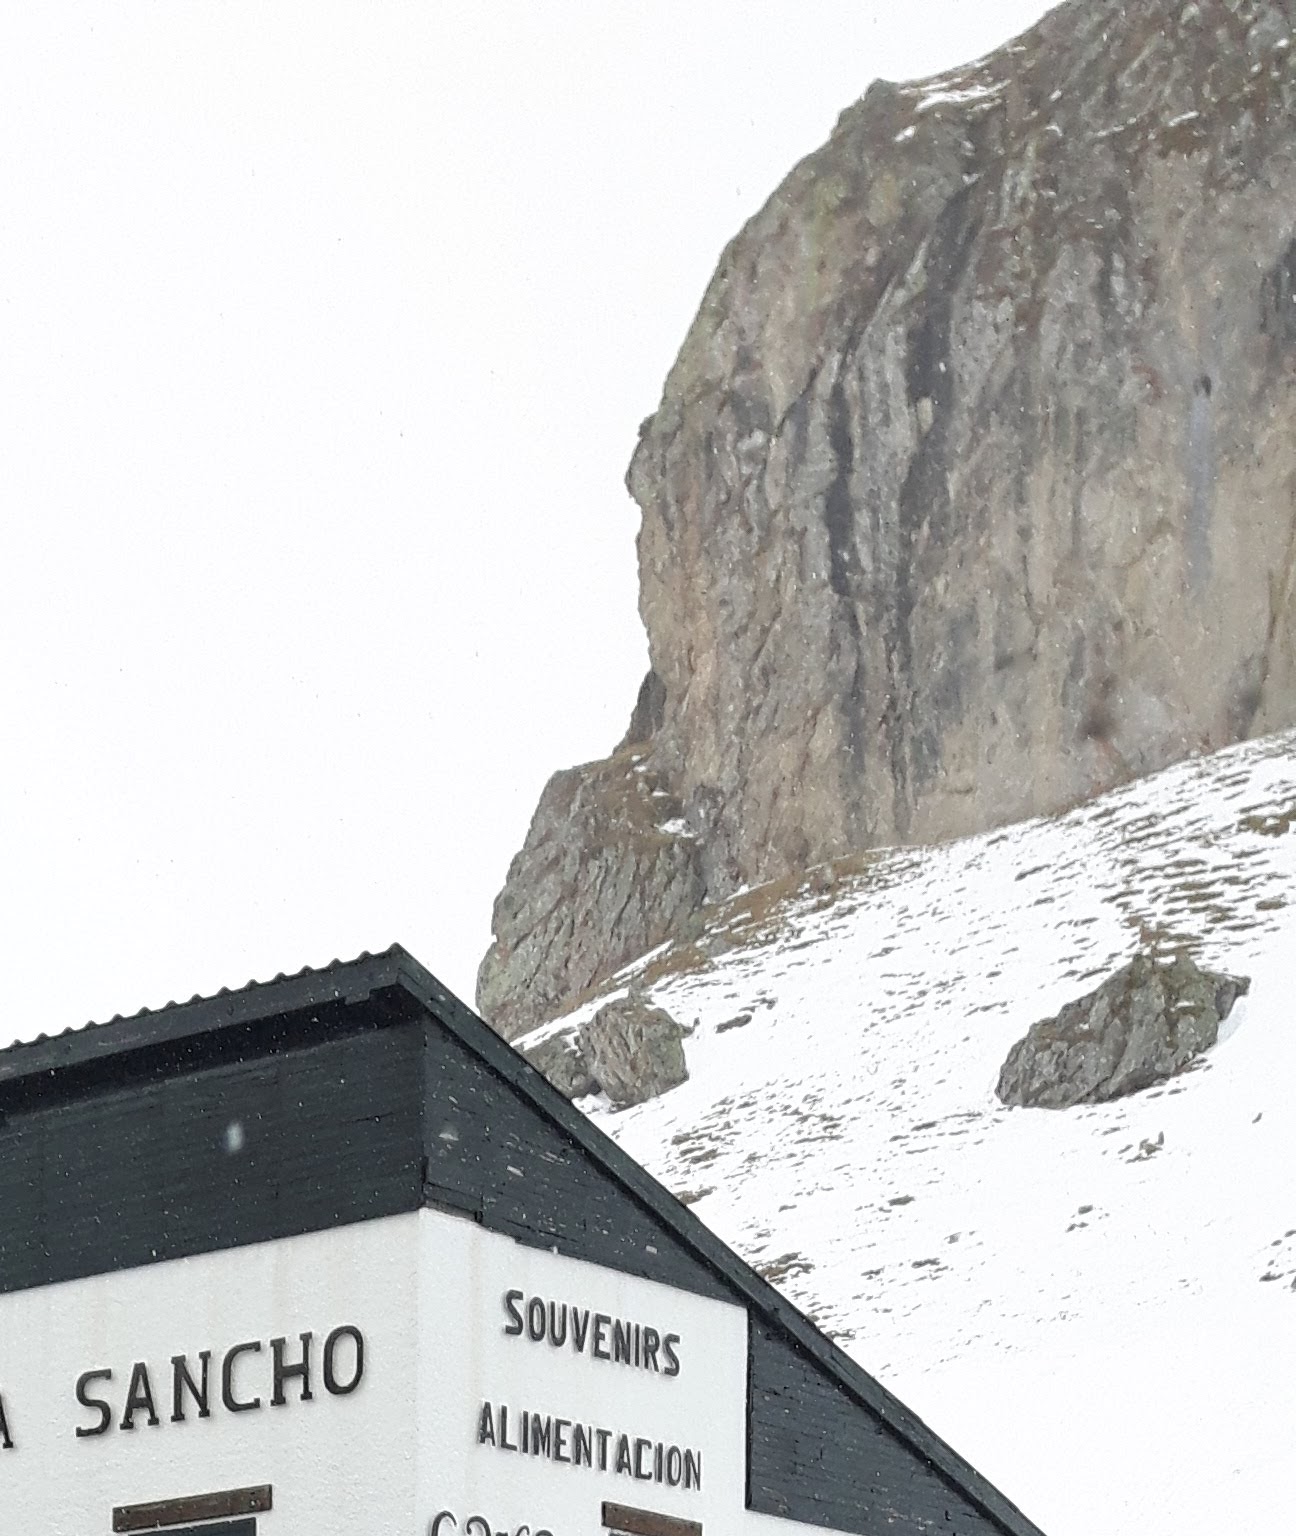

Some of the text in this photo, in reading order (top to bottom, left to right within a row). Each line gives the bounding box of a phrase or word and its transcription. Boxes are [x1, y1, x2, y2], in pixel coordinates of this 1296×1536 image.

[504, 1289, 681, 1377] SOUVENIRS
[76, 1325, 365, 1438] SANCHO
[479, 1400, 702, 1491] ALIMENTACION
